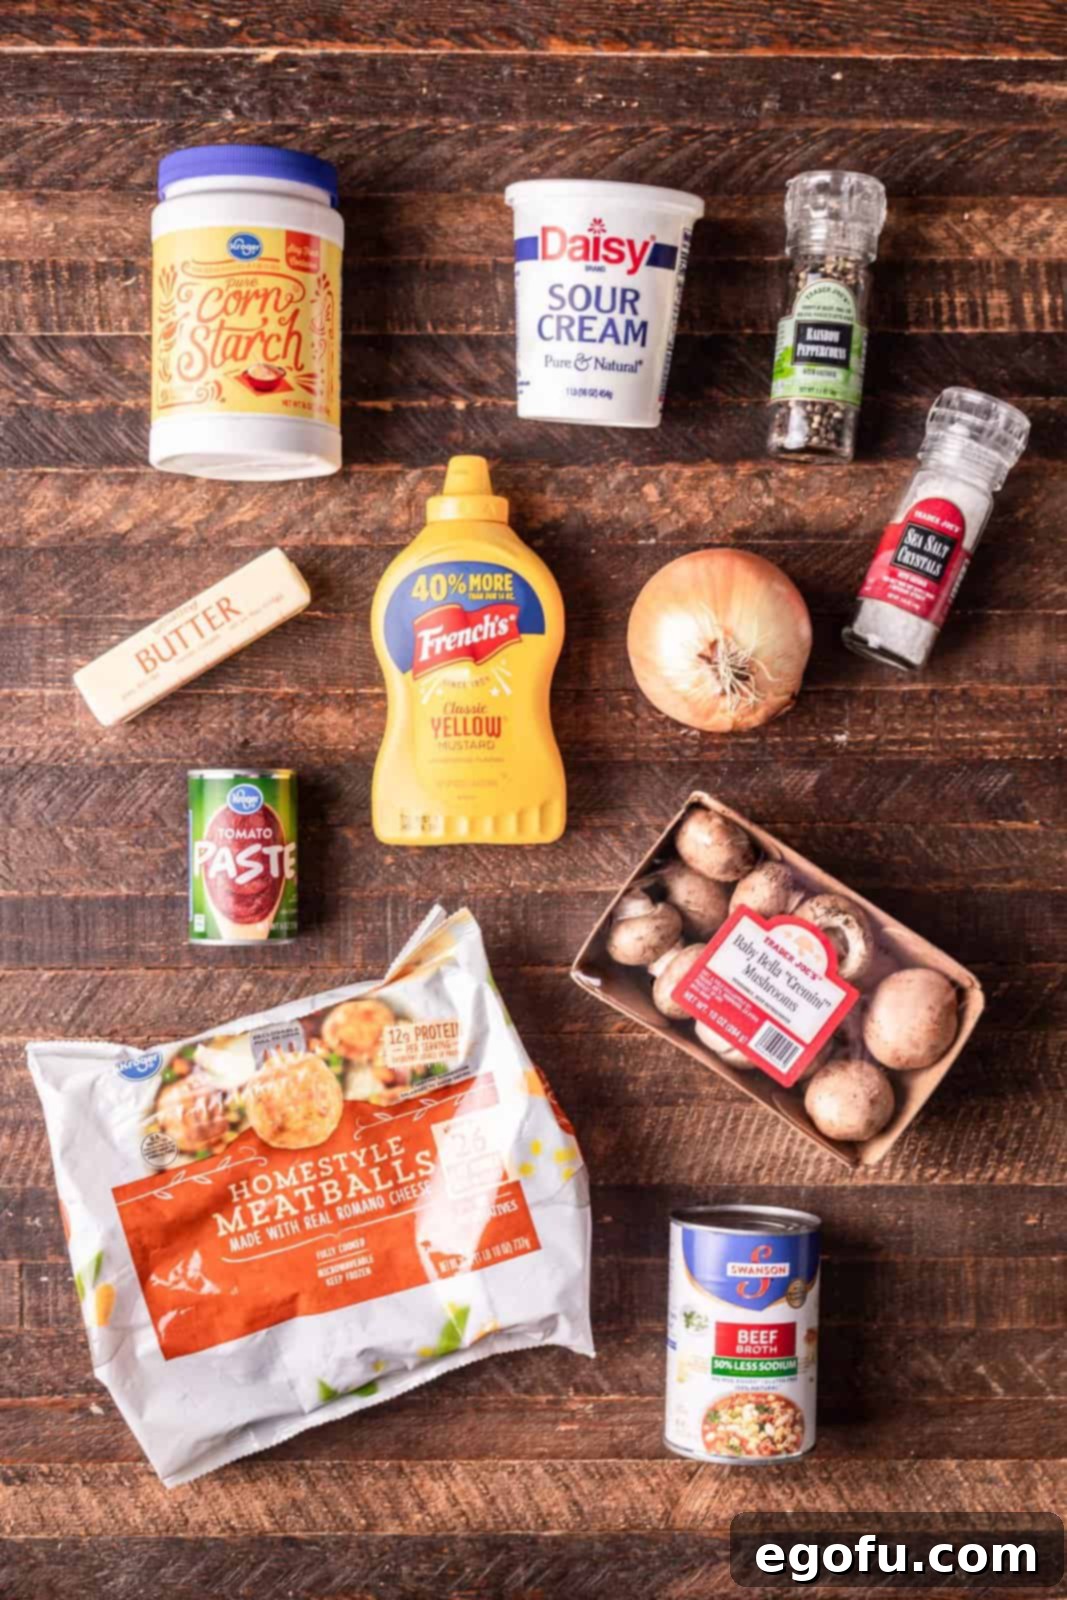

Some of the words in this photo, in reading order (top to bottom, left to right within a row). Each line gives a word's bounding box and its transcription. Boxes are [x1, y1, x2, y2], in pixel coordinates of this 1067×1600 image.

[548, 283, 640, 316] SOUR
[177, 309, 303, 382] Starch
[537, 314, 648, 348] CREAM
[544, 354, 571, 368] Pure
[574, 352, 592, 371] &
[897, 545, 943, 577] CRYSTALS
[411, 573, 467, 602] 40%
[468, 573, 514, 591] MORE
[134, 597, 242, 674] BUTTER
[417, 614, 510, 662] French's
[443, 702, 488, 715] Classic
[431, 716, 502, 739] YELLOW
[438, 740, 496, 751] MUSTARD
[217, 827, 273, 839] TOMATO
[194, 840, 297, 885] PASTE
[732, 933, 758, 962] Baby
[757, 952, 784, 979] Bella
[763, 936, 796, 963] TRADER
[742, 963, 800, 1013] Mushrooms
[116, 1051, 159, 1072] Kroger
[228, 1136, 406, 1203] HOMESTYLE
[212, 1150, 437, 1237] MEATBALLS
[229, 1230, 263, 1253] MADE
[266, 1218, 300, 1241] WITH
[303, 1209, 333, 1231] REAL
[336, 1194, 386, 1221] ROMANO
[731, 1265, 787, 1275] SWANSON
[735, 1345, 778, 1354] BROTH
[737, 1329, 778, 1345] BEEF
[734, 1361, 758, 1371] LESS
[759, 1359, 797, 1371] SODIUM
